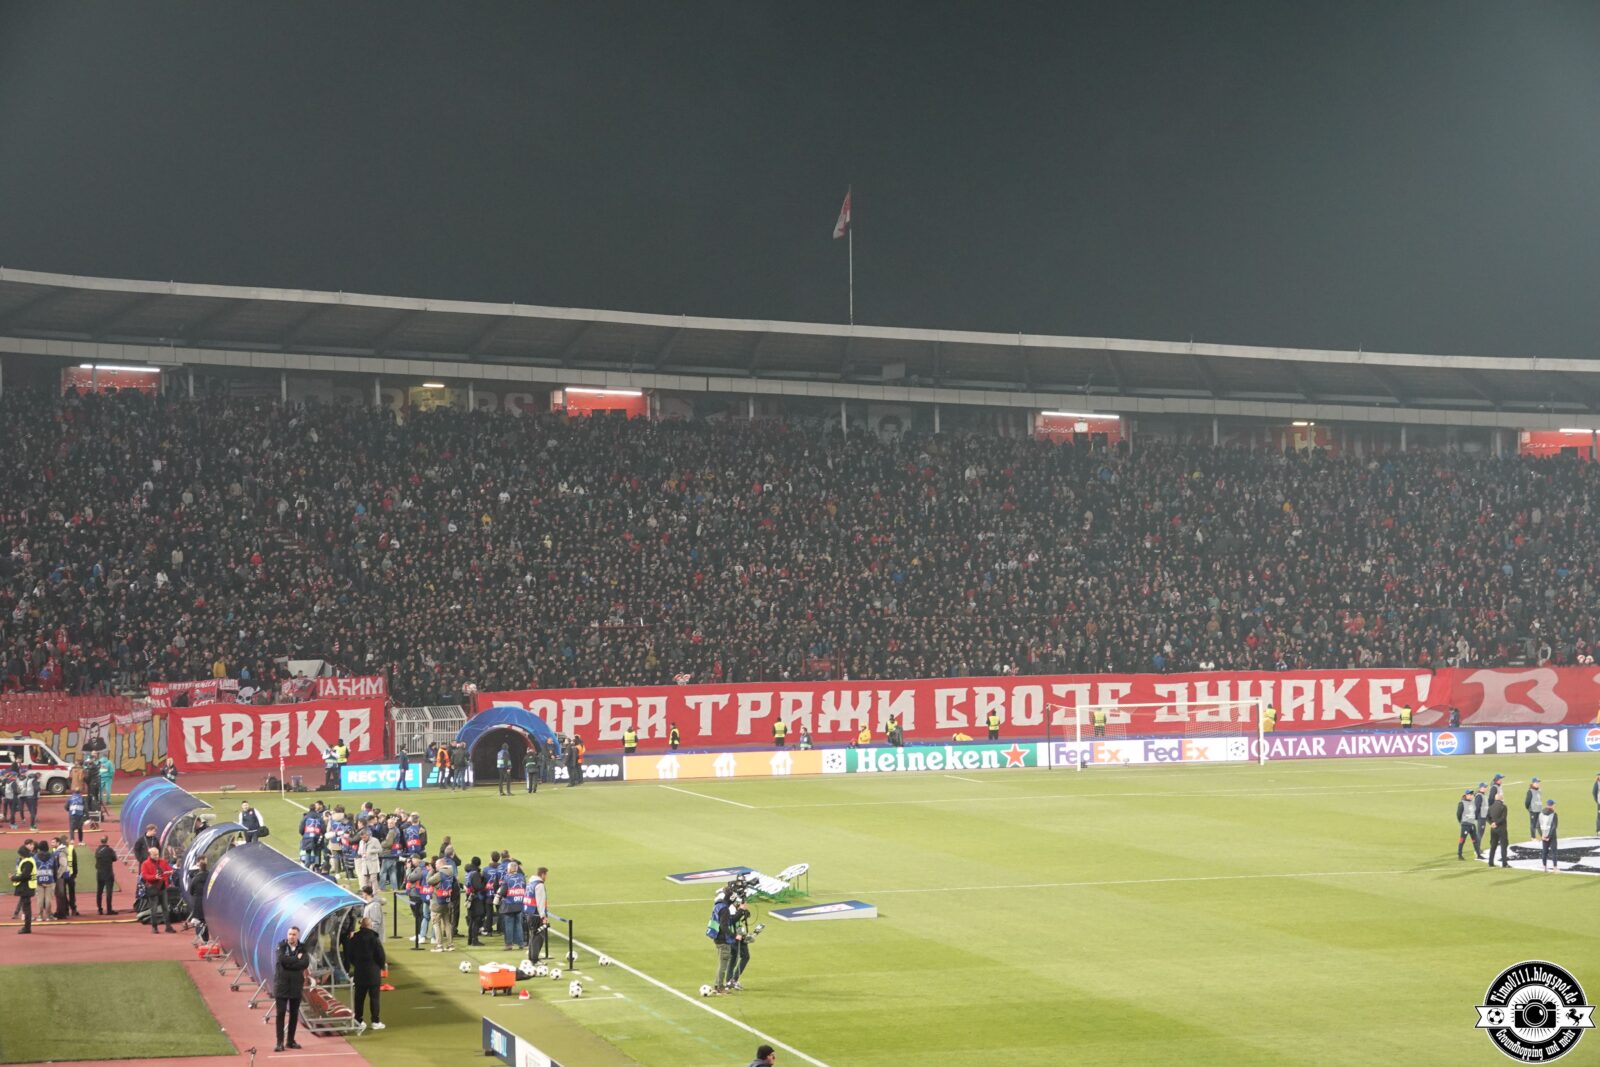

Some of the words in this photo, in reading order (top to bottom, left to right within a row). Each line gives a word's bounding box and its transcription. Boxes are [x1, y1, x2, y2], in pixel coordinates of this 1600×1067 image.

[492, 696, 668, 741] ОРБА
[684, 689, 916, 738] ТРАЖИ
[1054, 742, 1121, 764] FedEx
[1143, 739, 1209, 762] FedEx
[1250, 737, 1327, 760] QATAR
[1335, 734, 1429, 755] AIRWAYS
[1474, 728, 1569, 755] PEPSI
[856, 746, 1000, 773] Heineken
